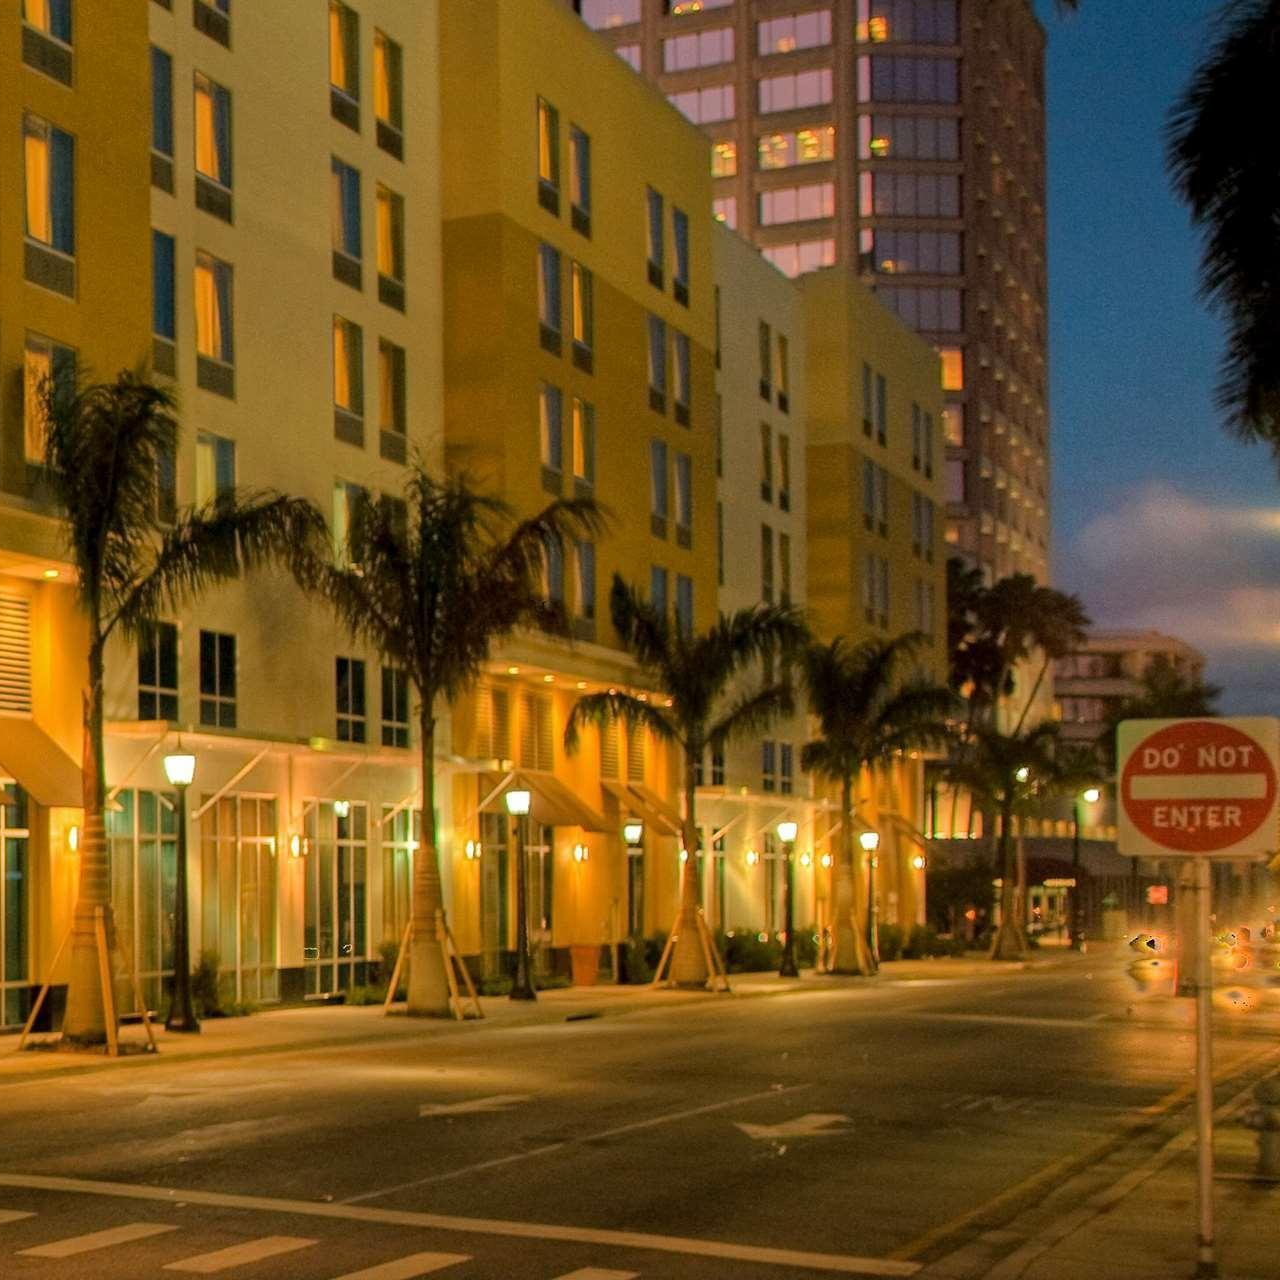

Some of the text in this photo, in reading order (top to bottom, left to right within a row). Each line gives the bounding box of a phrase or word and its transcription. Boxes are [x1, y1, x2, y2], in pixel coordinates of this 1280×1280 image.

[1143, 745, 1252, 769] DO NOT
[1153, 806, 1241, 828] ENTER
